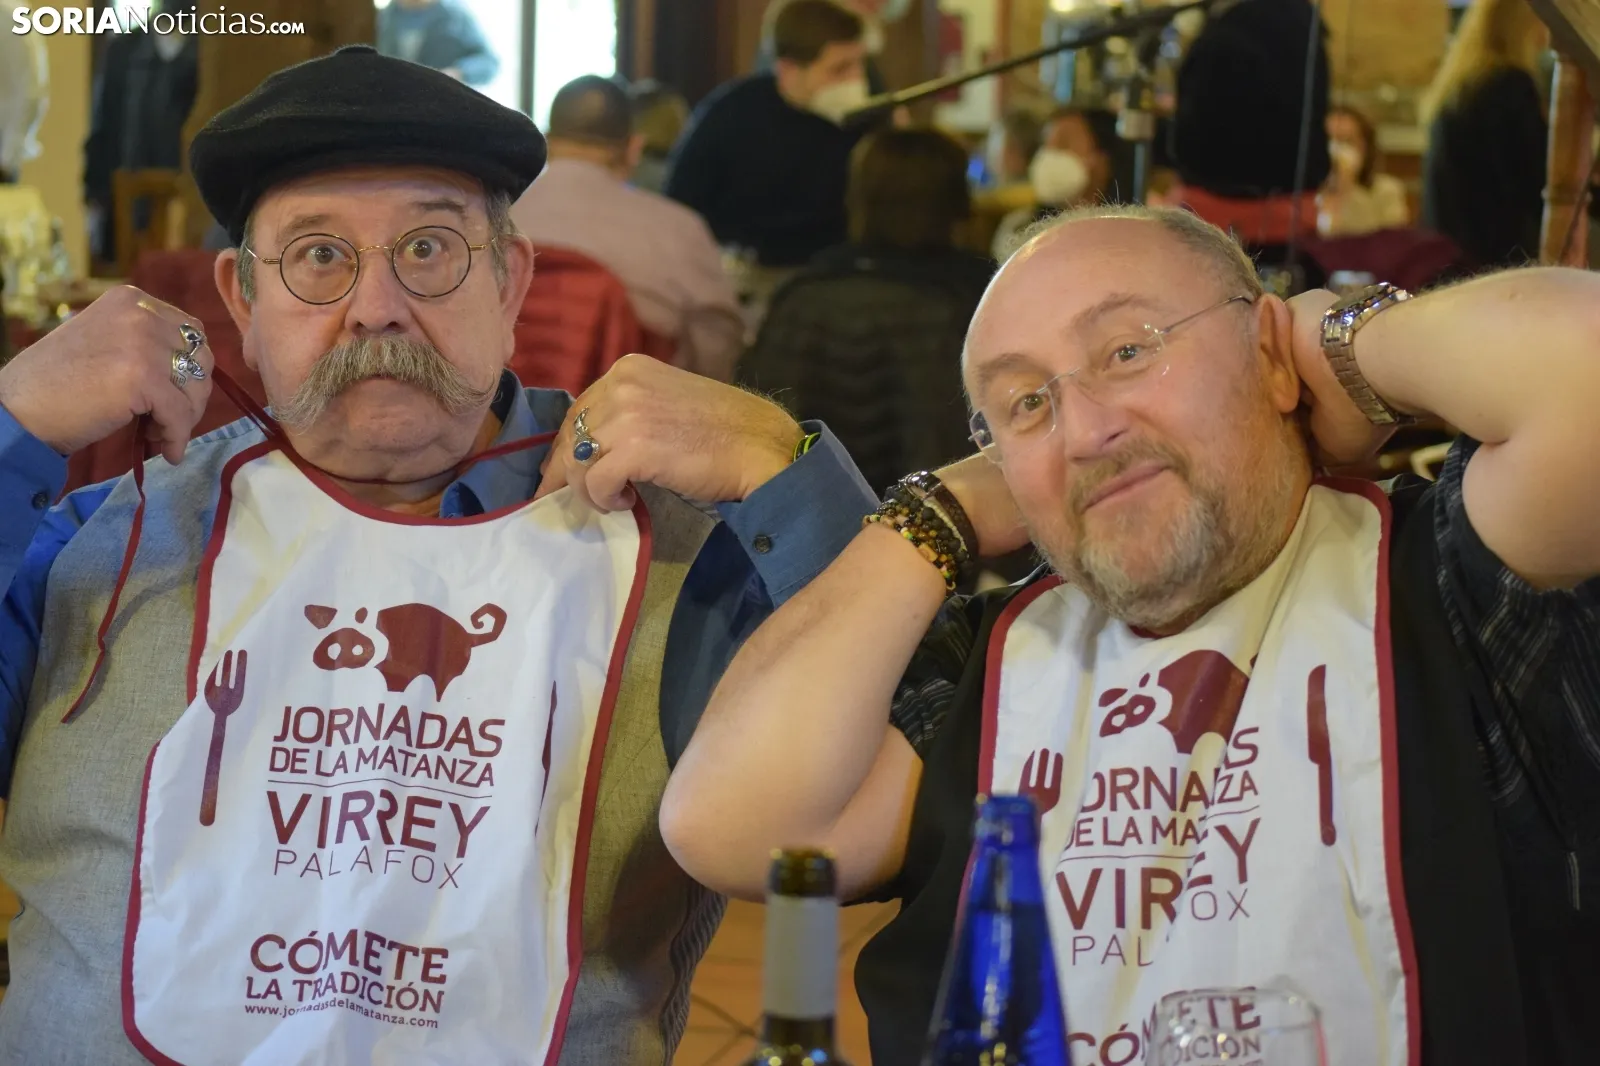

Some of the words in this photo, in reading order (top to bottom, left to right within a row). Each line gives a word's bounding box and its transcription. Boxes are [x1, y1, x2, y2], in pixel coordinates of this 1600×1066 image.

[273, 703, 506, 758] JORNADAS
[269, 746, 309, 775] DE
[315, 751, 348, 777] LA
[355, 745, 494, 788] MATANZA
[266, 788, 491, 859] VIRREY
[1102, 816, 1142, 846] LA
[273, 845, 463, 889] PALAFOX
[249, 928, 449, 985] CÓMETE
[244, 998, 439, 1029] www.jornadasdelamatanza.com
[246, 976, 282, 1001] LA
[292, 971, 445, 1014] TRADICIÓN
